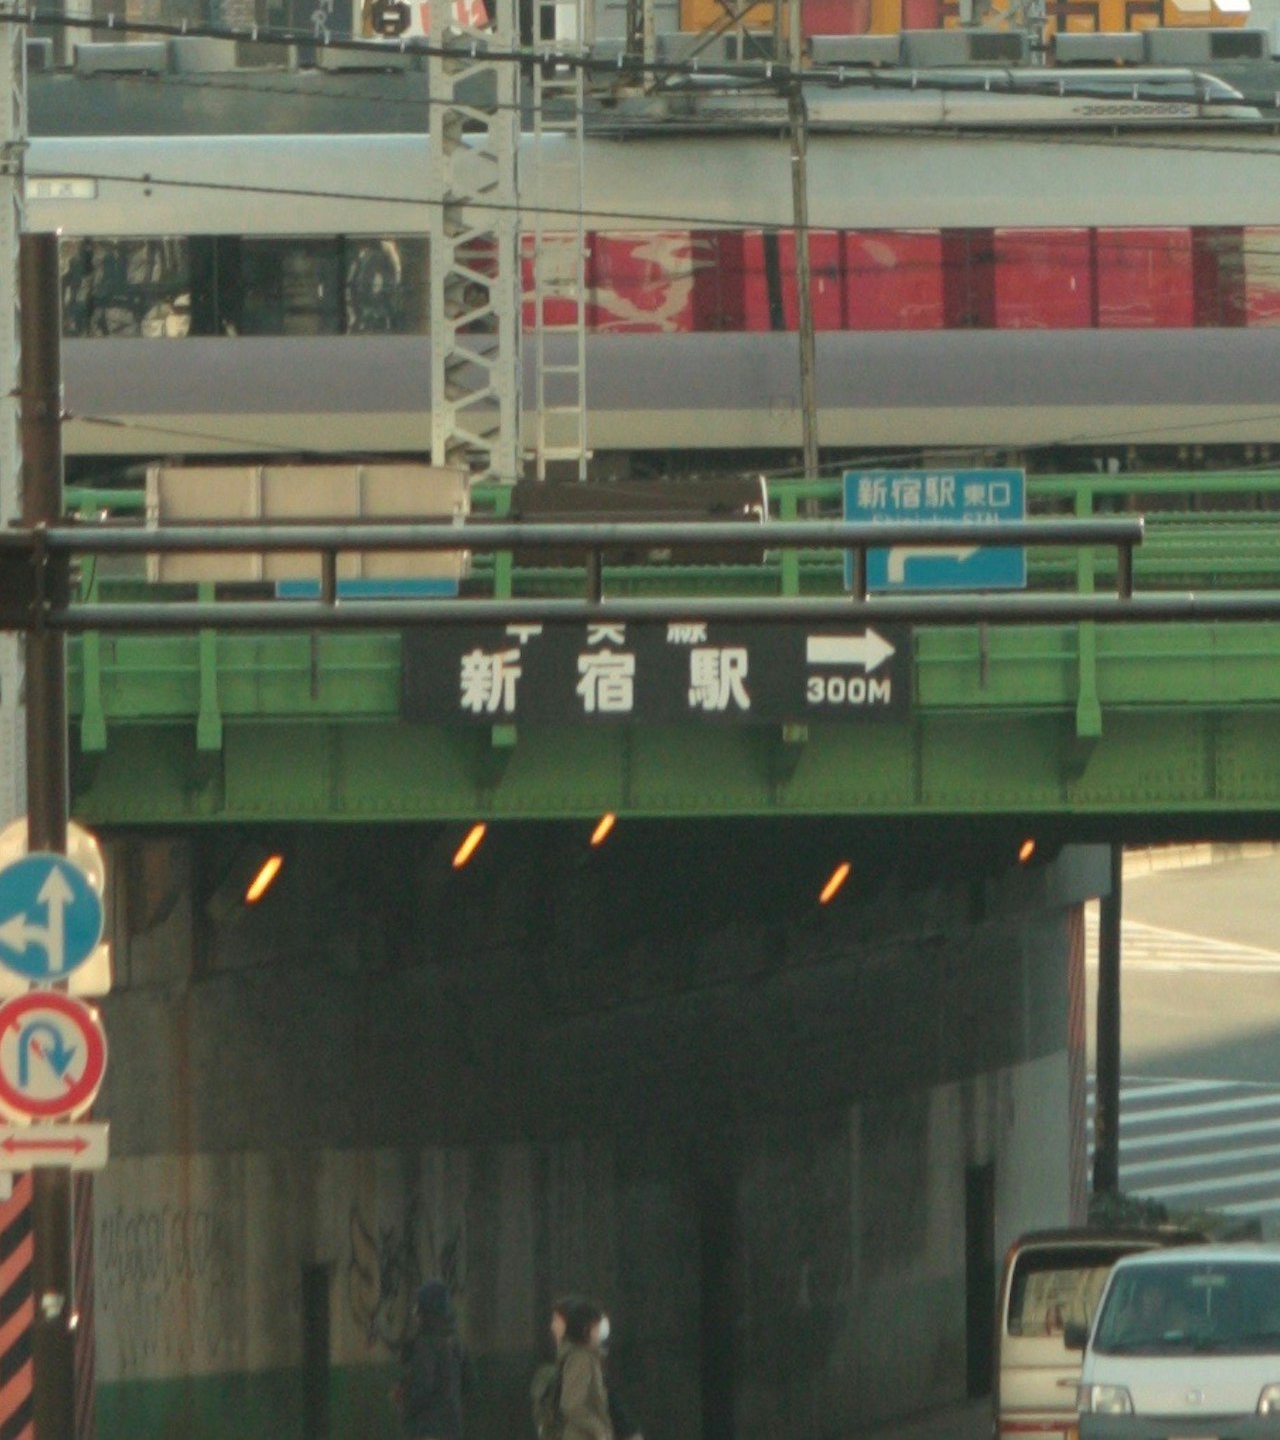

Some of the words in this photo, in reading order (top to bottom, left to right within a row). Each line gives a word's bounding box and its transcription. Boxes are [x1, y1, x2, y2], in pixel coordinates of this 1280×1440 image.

[458, 650, 750, 714] 新宿駅
[806, 677, 891, 706] 300M
